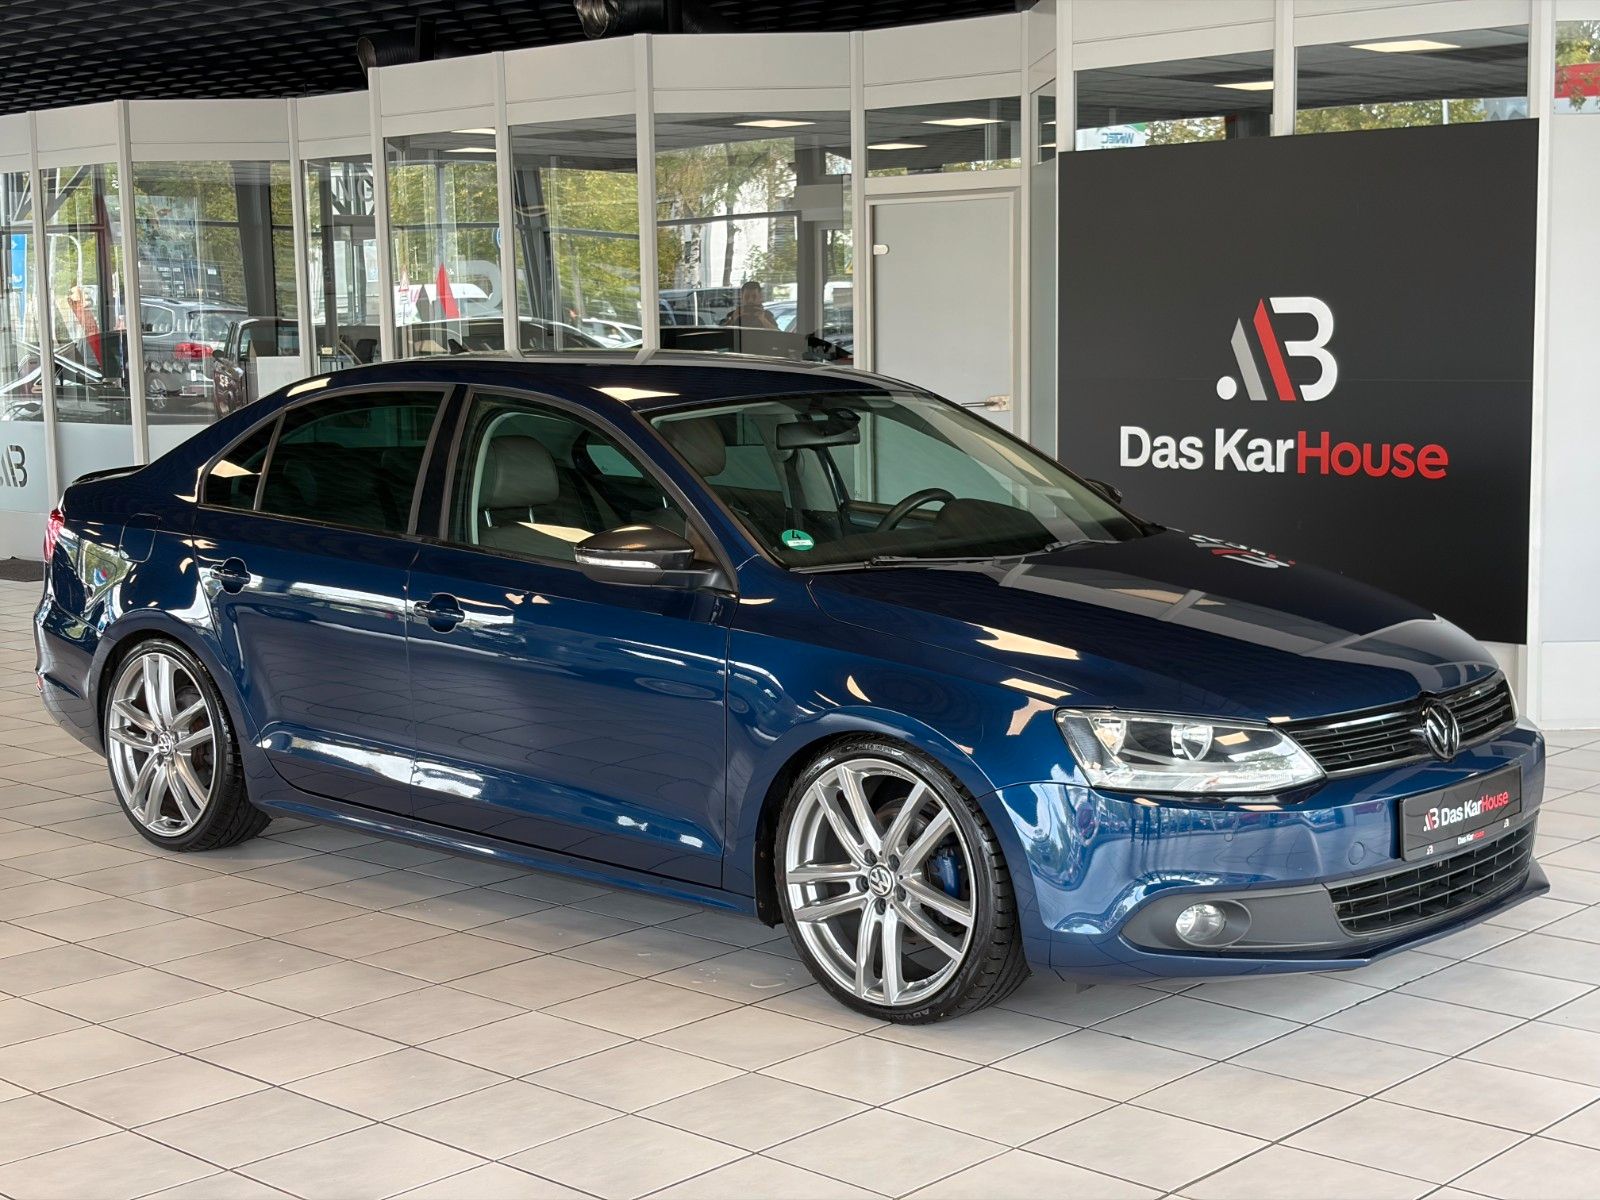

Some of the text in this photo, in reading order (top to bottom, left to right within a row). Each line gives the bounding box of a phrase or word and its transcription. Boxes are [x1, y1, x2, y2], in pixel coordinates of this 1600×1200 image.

[1119, 425, 1449, 480] Das KarHouse
[1441, 806, 1464, 826] Das
[1464, 791, 1509, 820] KarHouse
